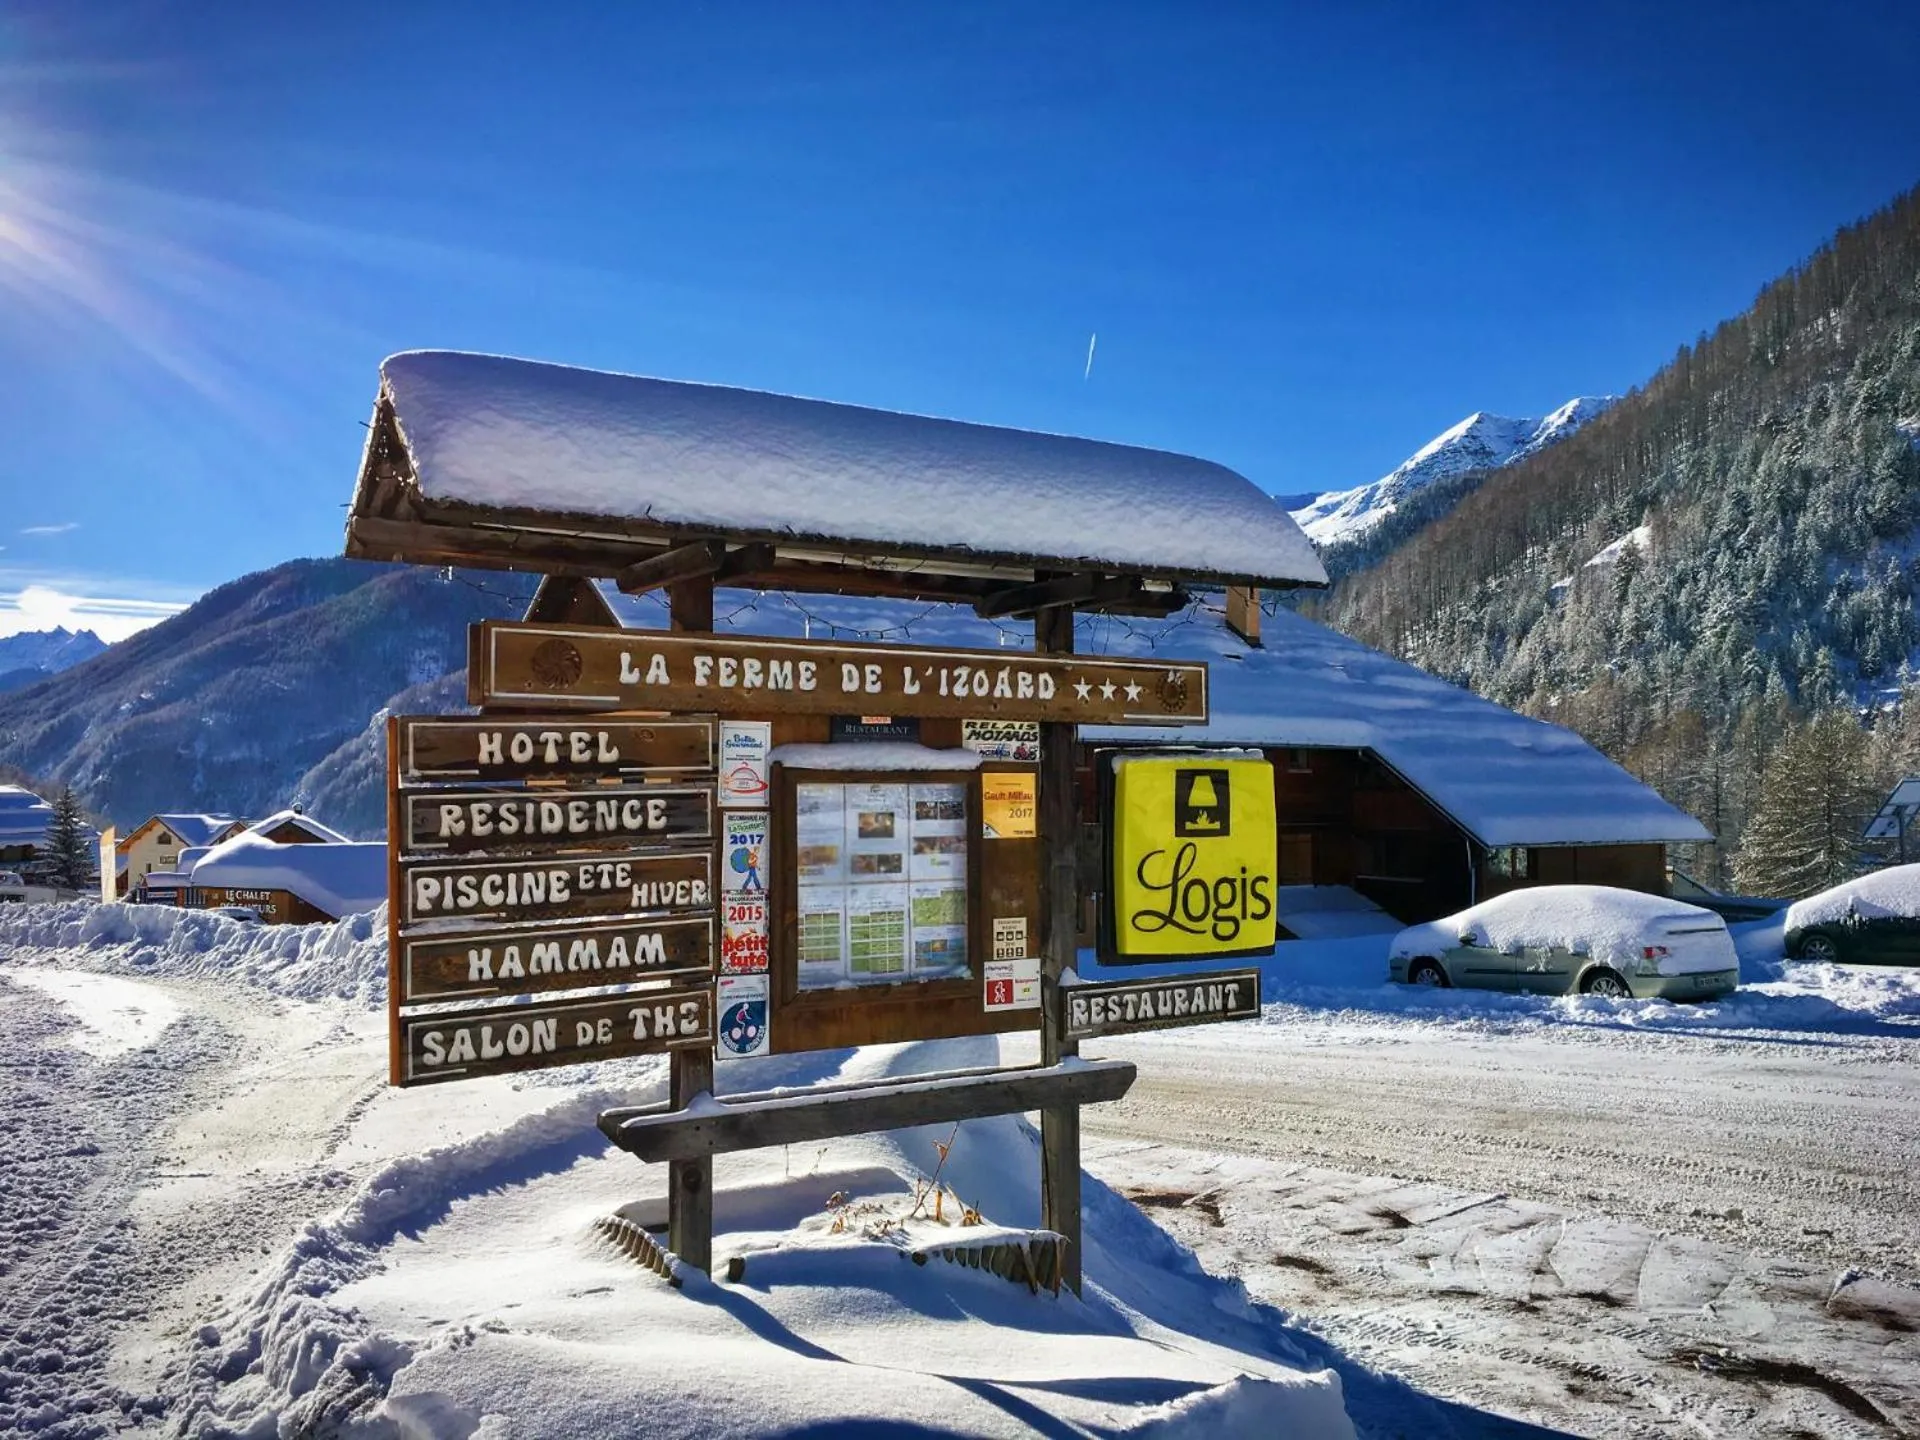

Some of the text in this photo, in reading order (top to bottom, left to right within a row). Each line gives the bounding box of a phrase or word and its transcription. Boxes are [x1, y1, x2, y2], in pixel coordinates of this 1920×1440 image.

[619, 652, 1055, 700] LA FERME DE L'IZOARD
[845, 724, 910, 735] RESTAURANT
[964, 721, 1037, 731] RELAIS
[966, 730, 1039, 742] MOTARDS
[478, 731, 620, 764] HOTEL
[439, 799, 668, 837] RESIDENCE
[1008, 807, 1033, 819] 2017
[729, 833, 765, 845] 2017
[235, 890, 271, 901] CHALET
[416, 863, 709, 911] PISCINE ETE HIVER
[1131, 842, 1272, 942] Logis
[728, 905, 763, 921] 2015
[467, 933, 667, 982] HAMMAM
[722, 934, 768, 956] petit
[1072, 983, 1240, 1027] RESTAURANT
[421, 1018, 558, 1066] SALON
[576, 1018, 613, 1047] DE
[628, 1002, 700, 1041] THE
